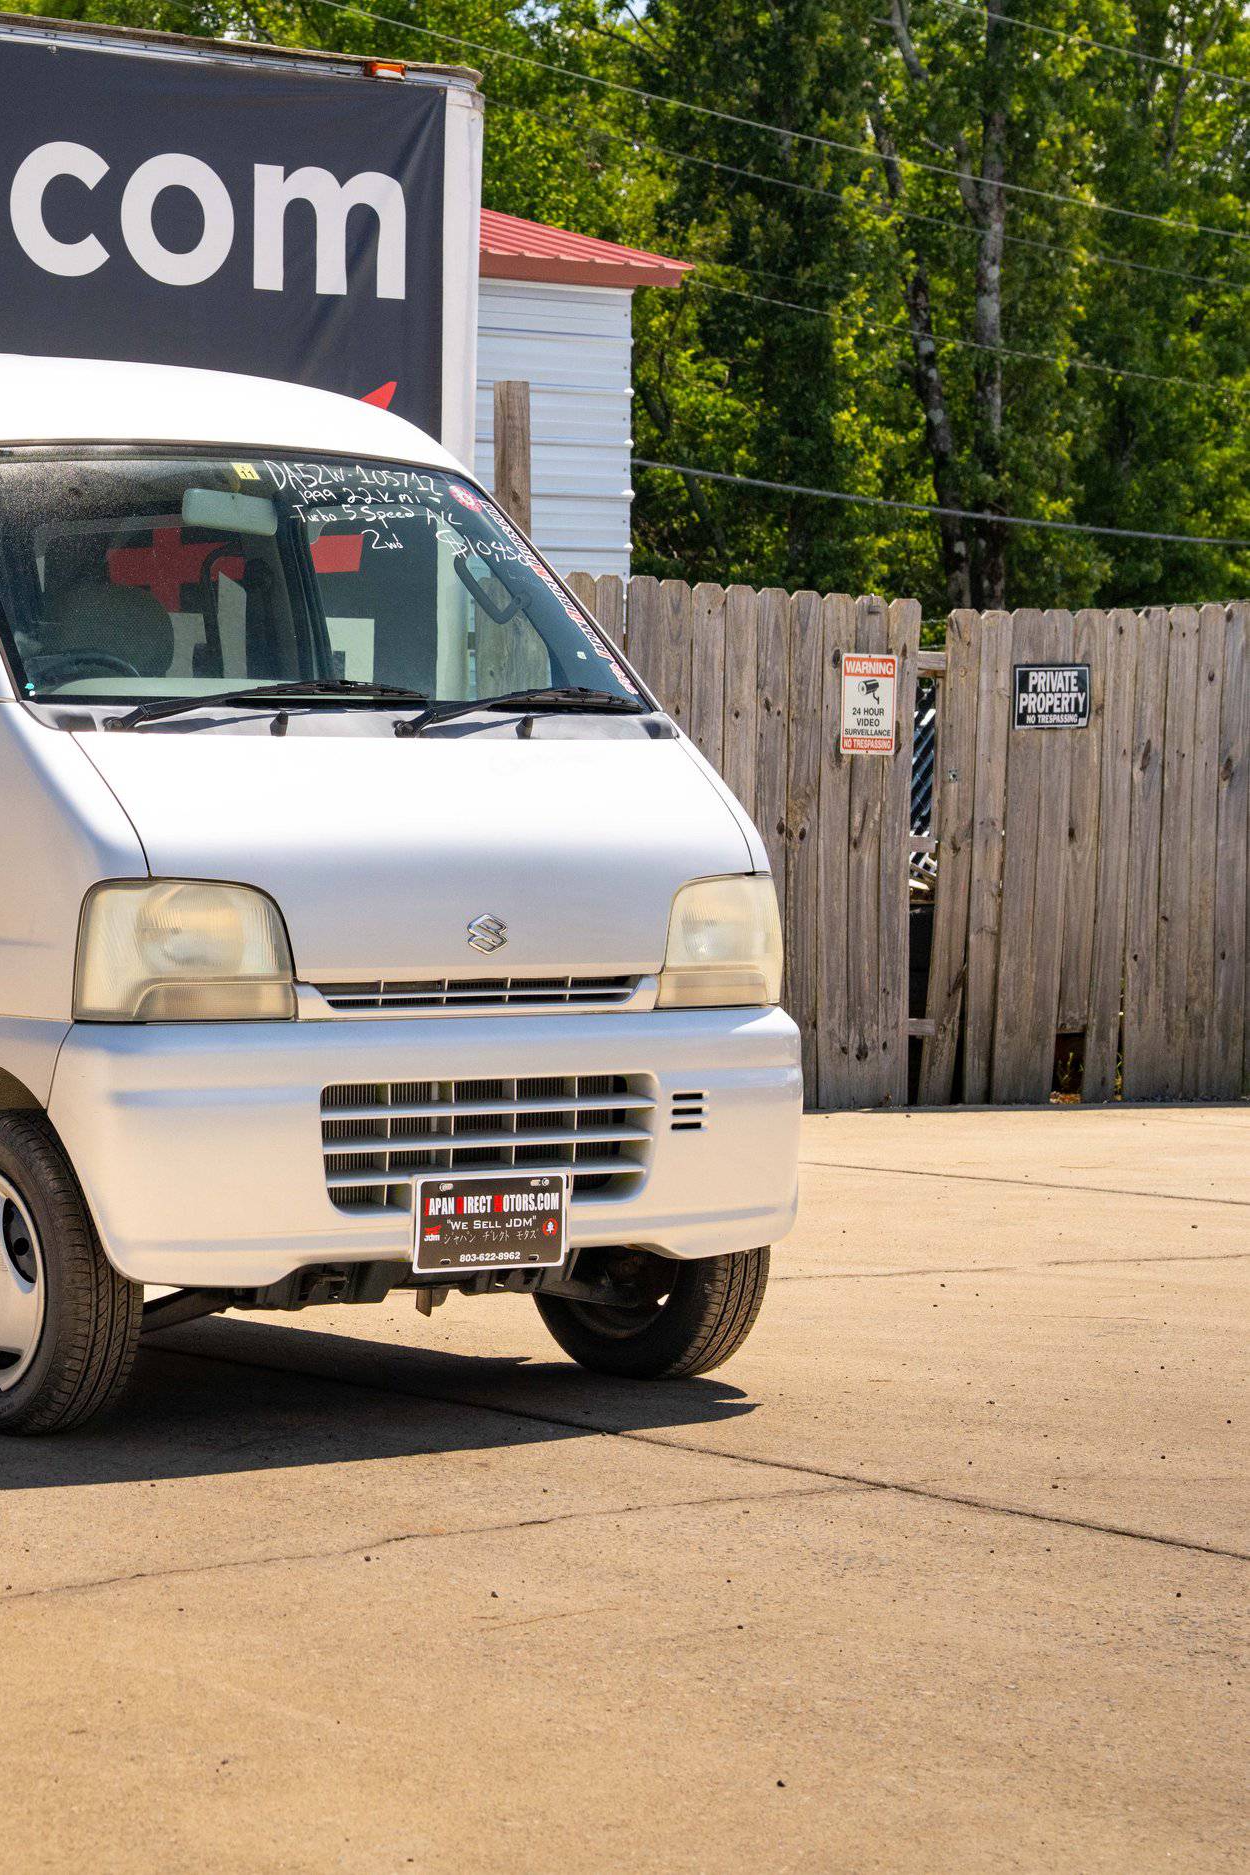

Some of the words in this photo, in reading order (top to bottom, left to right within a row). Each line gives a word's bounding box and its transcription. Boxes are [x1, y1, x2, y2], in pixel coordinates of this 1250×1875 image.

[299, 489, 338, 505] 1999
[292, 504, 338, 523] Turbo
[342, 504, 357, 521] 5
[360, 505, 415, 529] Speed
[845, 660, 894, 676] WARNING
[1028, 671, 1079, 693] PRIVATE
[1018, 692, 1087, 714] PROPERTY
[852, 707, 862, 716] 24
[863, 707, 885, 717] HOUR
[857, 718, 880, 727] VIDEO
[1026, 714, 1036, 724] NO
[1037, 713, 1079, 724] TRESPASSING
[844, 728, 891, 737] SURVEILLANCE
[844, 739, 852, 749] NO
[853, 739, 892, 751] TRESPASSING
[459, 1251, 521, 1263] 803-622-8962
